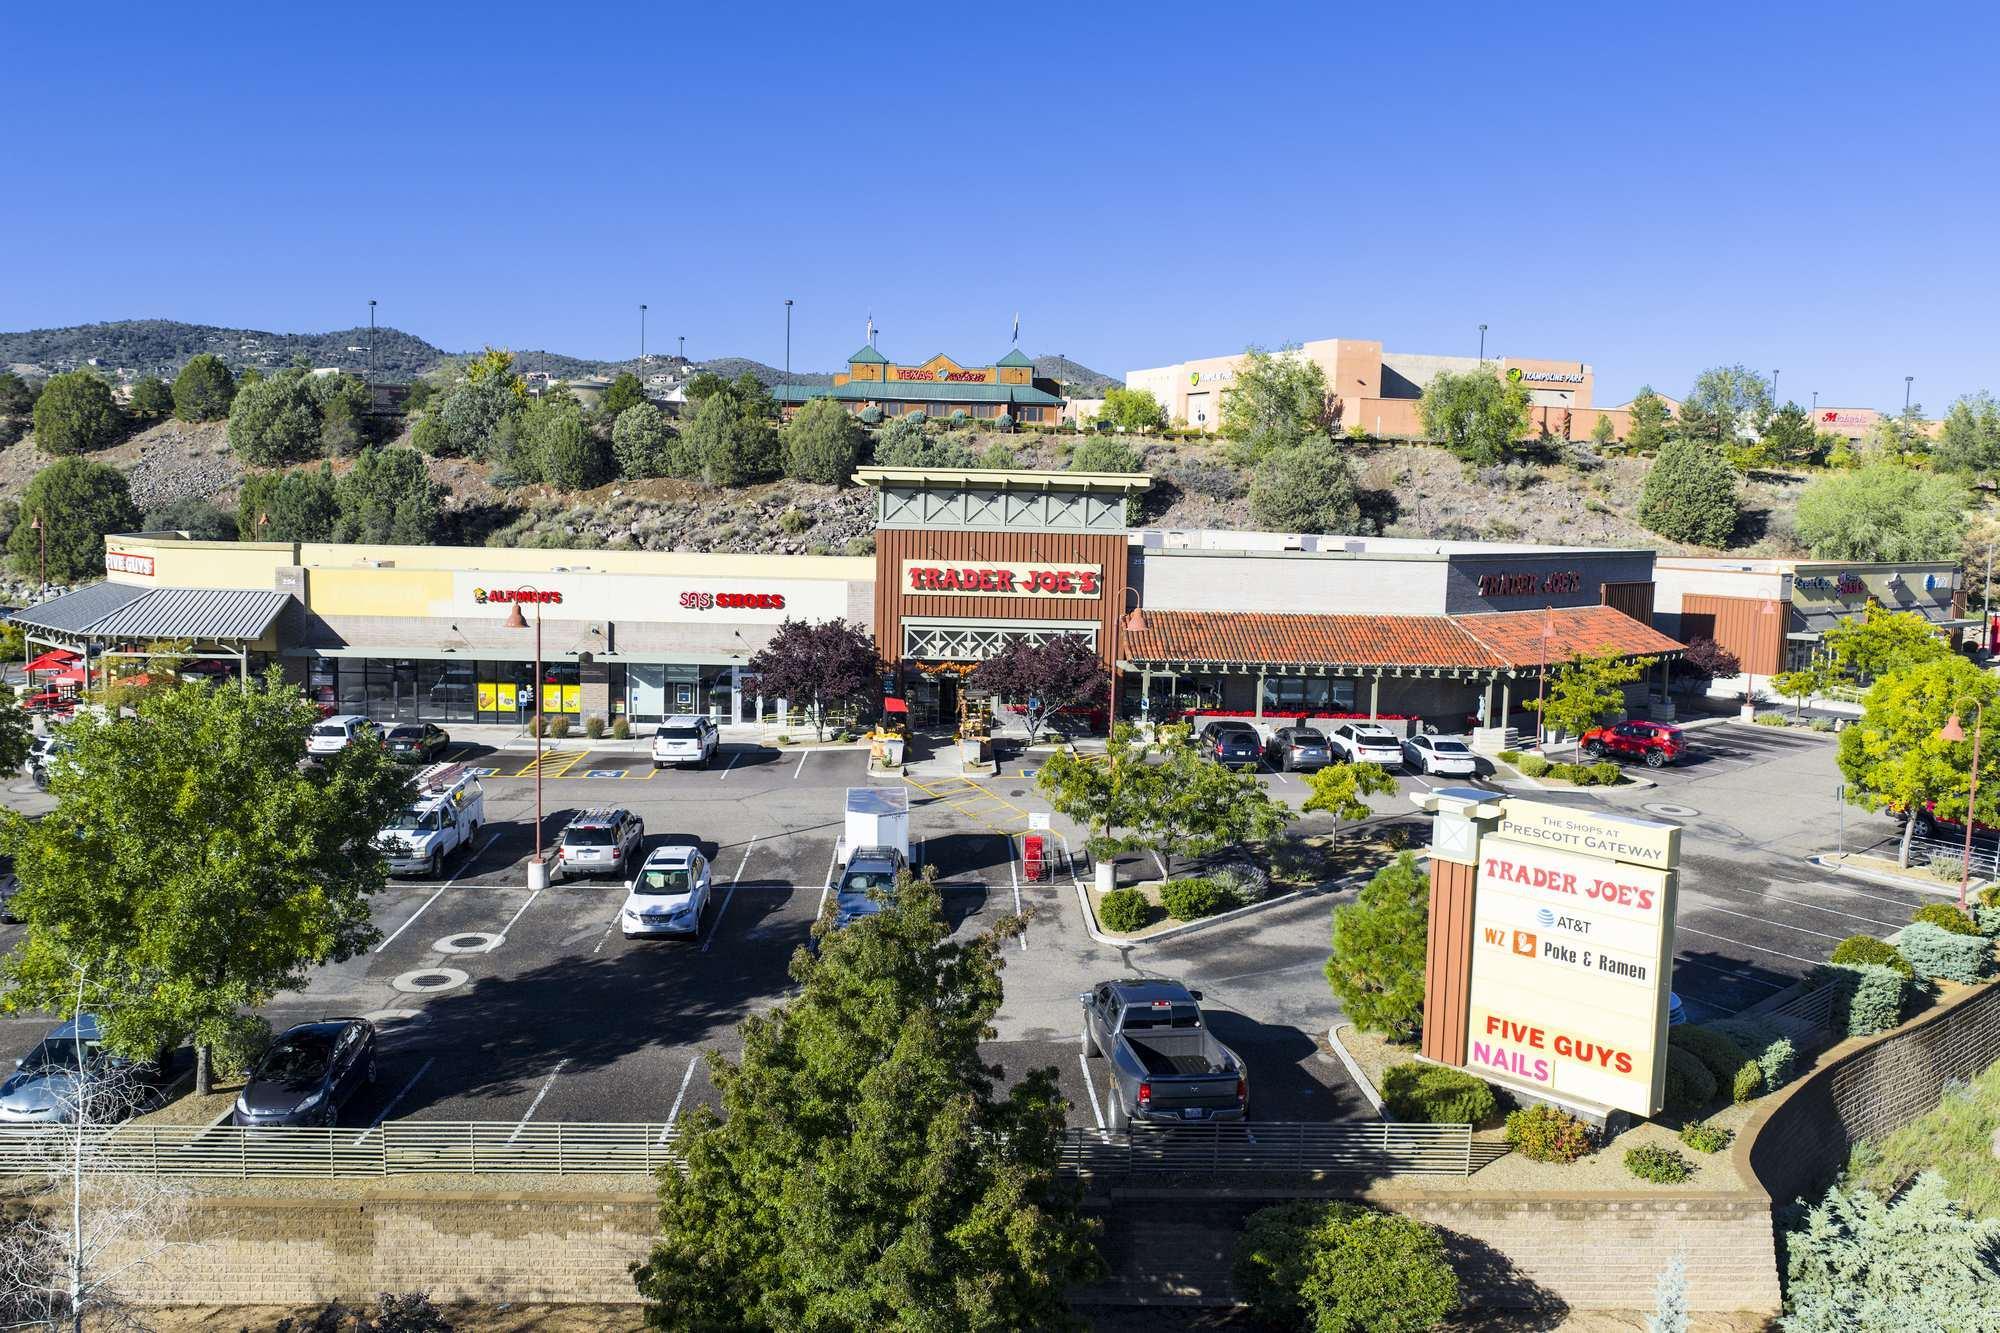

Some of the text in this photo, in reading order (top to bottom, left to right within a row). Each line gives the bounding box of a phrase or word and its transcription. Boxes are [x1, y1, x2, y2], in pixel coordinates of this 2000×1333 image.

[897, 369, 933, 381] TEXAS
[127, 556, 153, 575] GUYS
[908, 567, 1099, 594] TRADER JOE'S
[680, 592, 785, 609] SAS SHOES
[1502, 821, 1664, 860] PRESCOTT GATEWAY
[1542, 816, 1621, 839] THE SHOPS AT
[1485, 858, 1656, 910] TRADER JOE'S
[1557, 916, 1592, 934] AT&T
[1484, 927, 1647, 981] WZ Poke & Ramen
[1486, 1015, 1633, 1074] FIVE GUYS
[1473, 1041, 1549, 1082] NAILS
